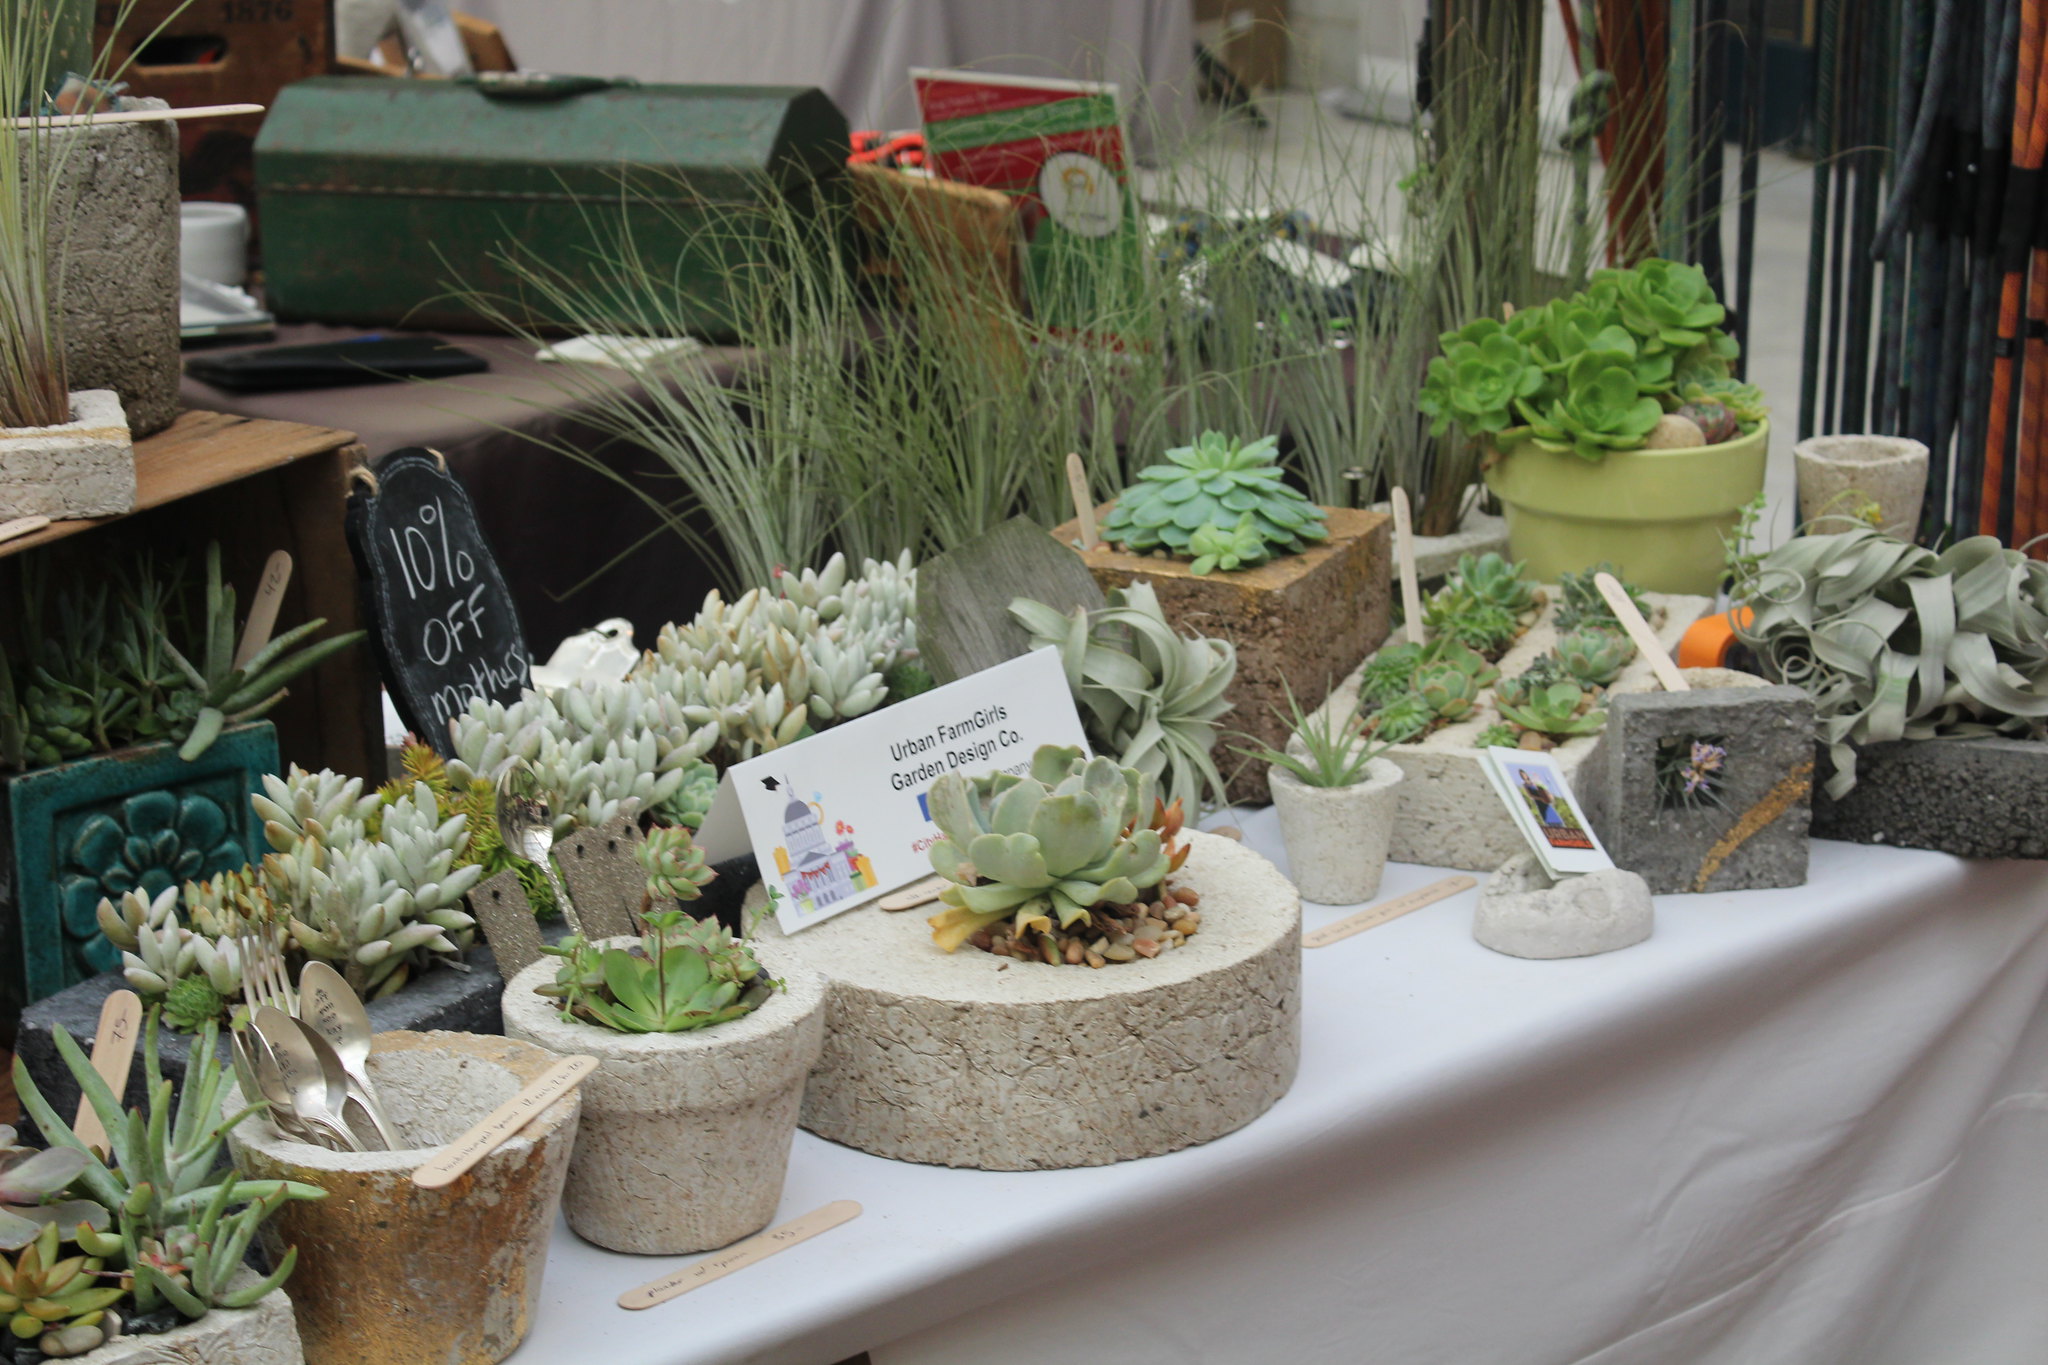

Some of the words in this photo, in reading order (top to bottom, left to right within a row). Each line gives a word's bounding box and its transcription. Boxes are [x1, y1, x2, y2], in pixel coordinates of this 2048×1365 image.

[389, 495, 475, 600] 10%
[423, 583, 485, 666] OFF
[890, 733, 936, 762] Urban
[937, 704, 1008, 744] FarmGirls
[890, 759, 946, 791] Garden
[946, 738, 998, 770] Design
[998, 729, 1024, 748] Co.
